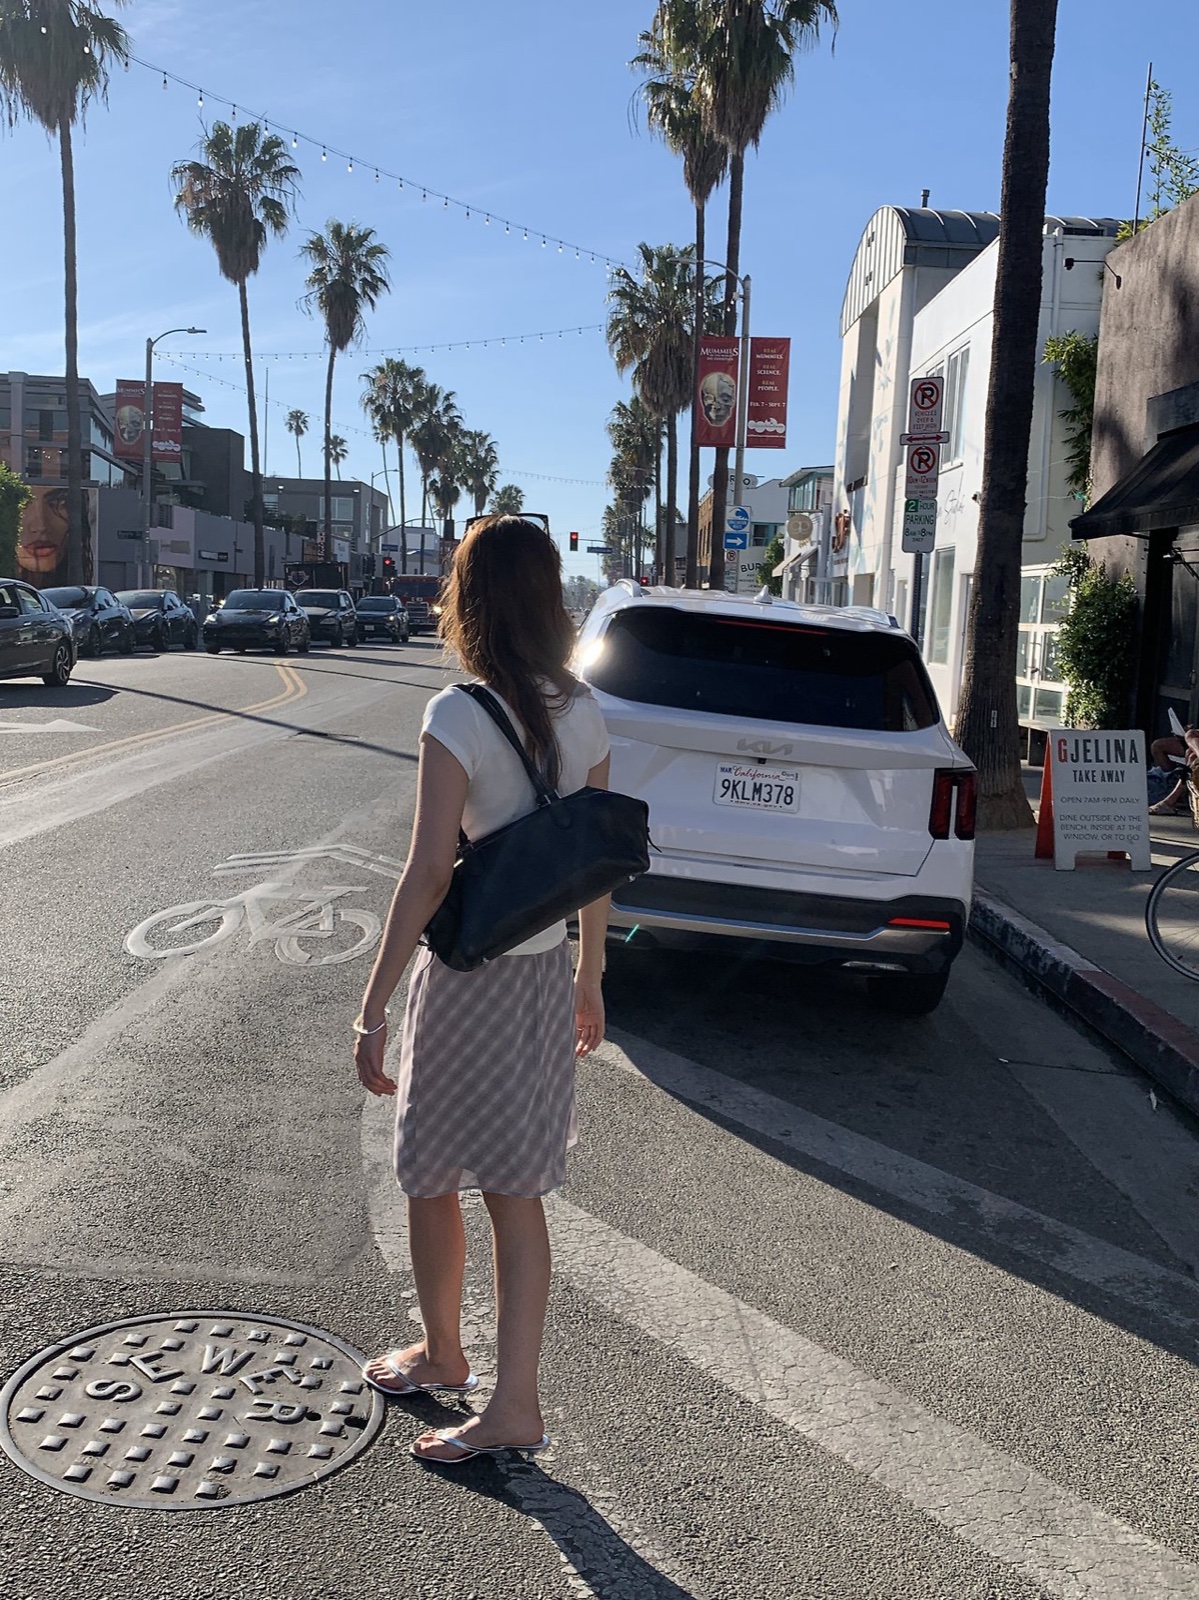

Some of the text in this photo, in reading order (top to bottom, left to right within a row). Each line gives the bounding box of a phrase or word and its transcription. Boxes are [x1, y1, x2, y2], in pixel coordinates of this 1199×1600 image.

[700, 347, 739, 357] MUMMIES
[908, 500, 935, 512] 2 HOUR
[905, 514, 935, 525] PARKING
[740, 562, 762, 573] BUR
[1057, 738, 1139, 764] GJELINA
[732, 765, 784, 781] California
[1073, 769, 1126, 783] TAKE AWAY
[720, 778, 795, 806] 9KLM378
[1079, 814, 1112, 822] OUTSIDE
[1101, 833, 1113, 841] OR
[84, 1343, 304, 1425] SEWER
